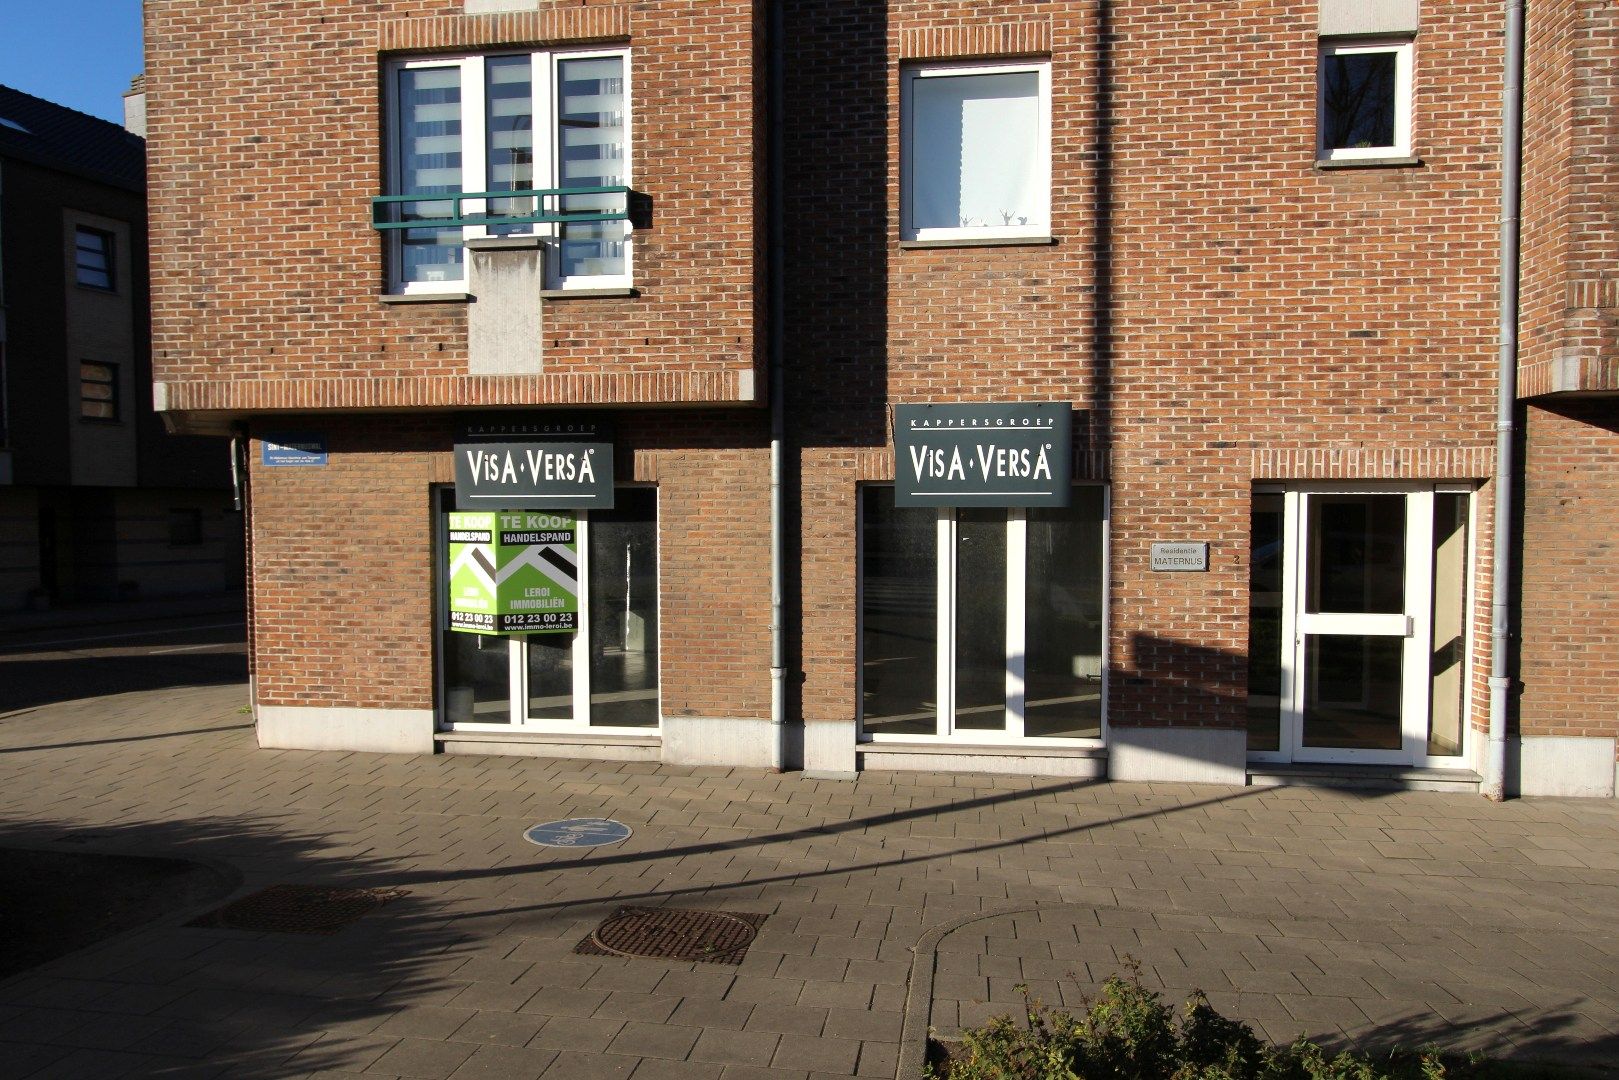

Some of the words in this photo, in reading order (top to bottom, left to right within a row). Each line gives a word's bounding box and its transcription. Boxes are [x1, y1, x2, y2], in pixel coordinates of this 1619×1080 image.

[911, 418, 1054, 427] KAPPERSGROEP
[467, 424, 596, 433] KAPPERSGROEP
[500, 515, 521, 529] TE
[526, 515, 572, 529] KOOP
[449, 531, 491, 542] HANDELSPAND
[503, 532, 571, 543] HANDELSPAND
[1154, 557, 1203, 565] MATERNUS
[1233, 554, 1240, 564] 2
[524, 587, 550, 598] LEROI
[510, 597, 565, 610] IMMOBILIËN
[451, 611, 464, 621] 012
[464, 612, 474, 622] 23
[474, 612, 483, 623] 00
[484, 614, 493, 624] 23
[504, 614, 525, 624] 012
[527, 614, 541, 623] 23
[543, 613, 557, 622] 00
[559, 613, 573, 622] 23
[504, 623, 573, 631] www.immo-leroi.be
